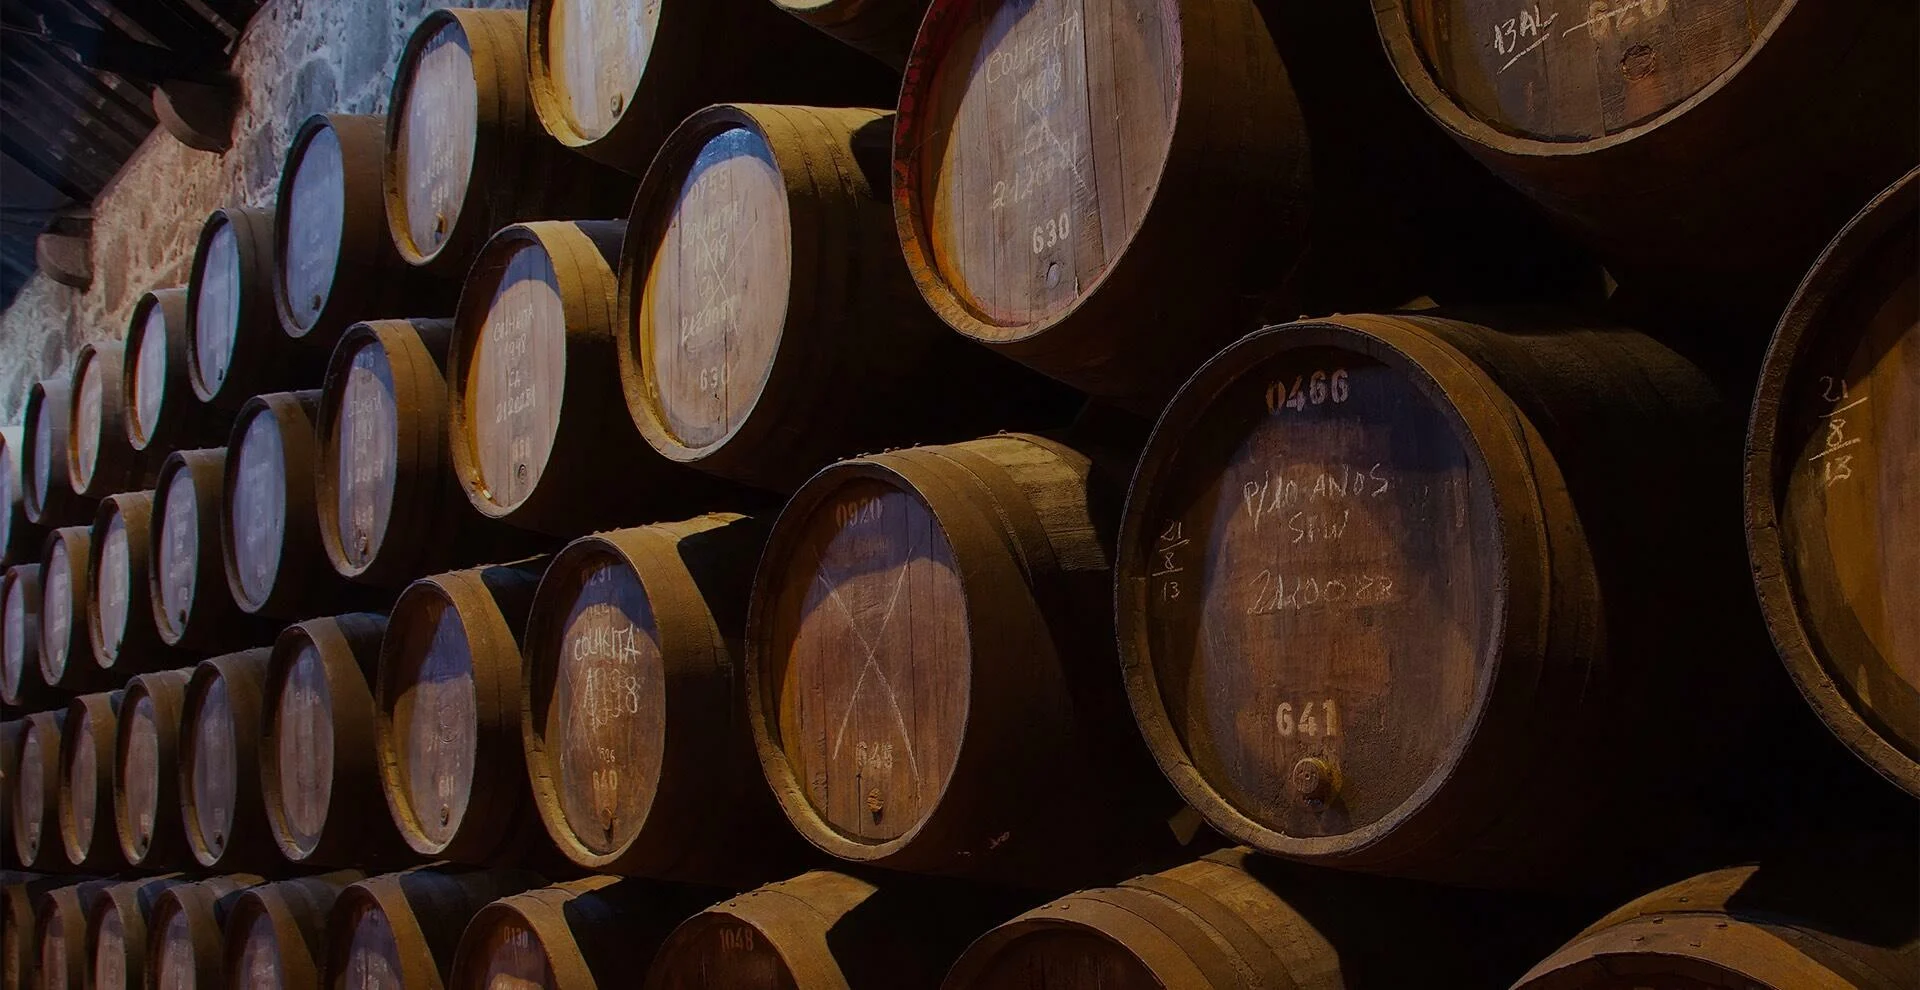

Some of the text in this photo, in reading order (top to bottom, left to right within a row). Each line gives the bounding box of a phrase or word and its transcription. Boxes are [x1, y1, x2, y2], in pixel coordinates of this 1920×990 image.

[1032, 211, 1070, 254] 630
[700, 361, 731, 393] 630
[1819, 375, 1849, 402] 21
[1265, 369, 1350, 415] 0466
[1826, 418, 1847, 447] 8
[836, 497, 884, 528] 0920
[1164, 552, 1175, 570] 8
[1163, 581, 1180, 601] 13
[1276, 699, 1337, 737] 641
[592, 769, 618, 792] 640
[503, 926, 528, 949] 0130
[719, 926, 754, 953] 1048
